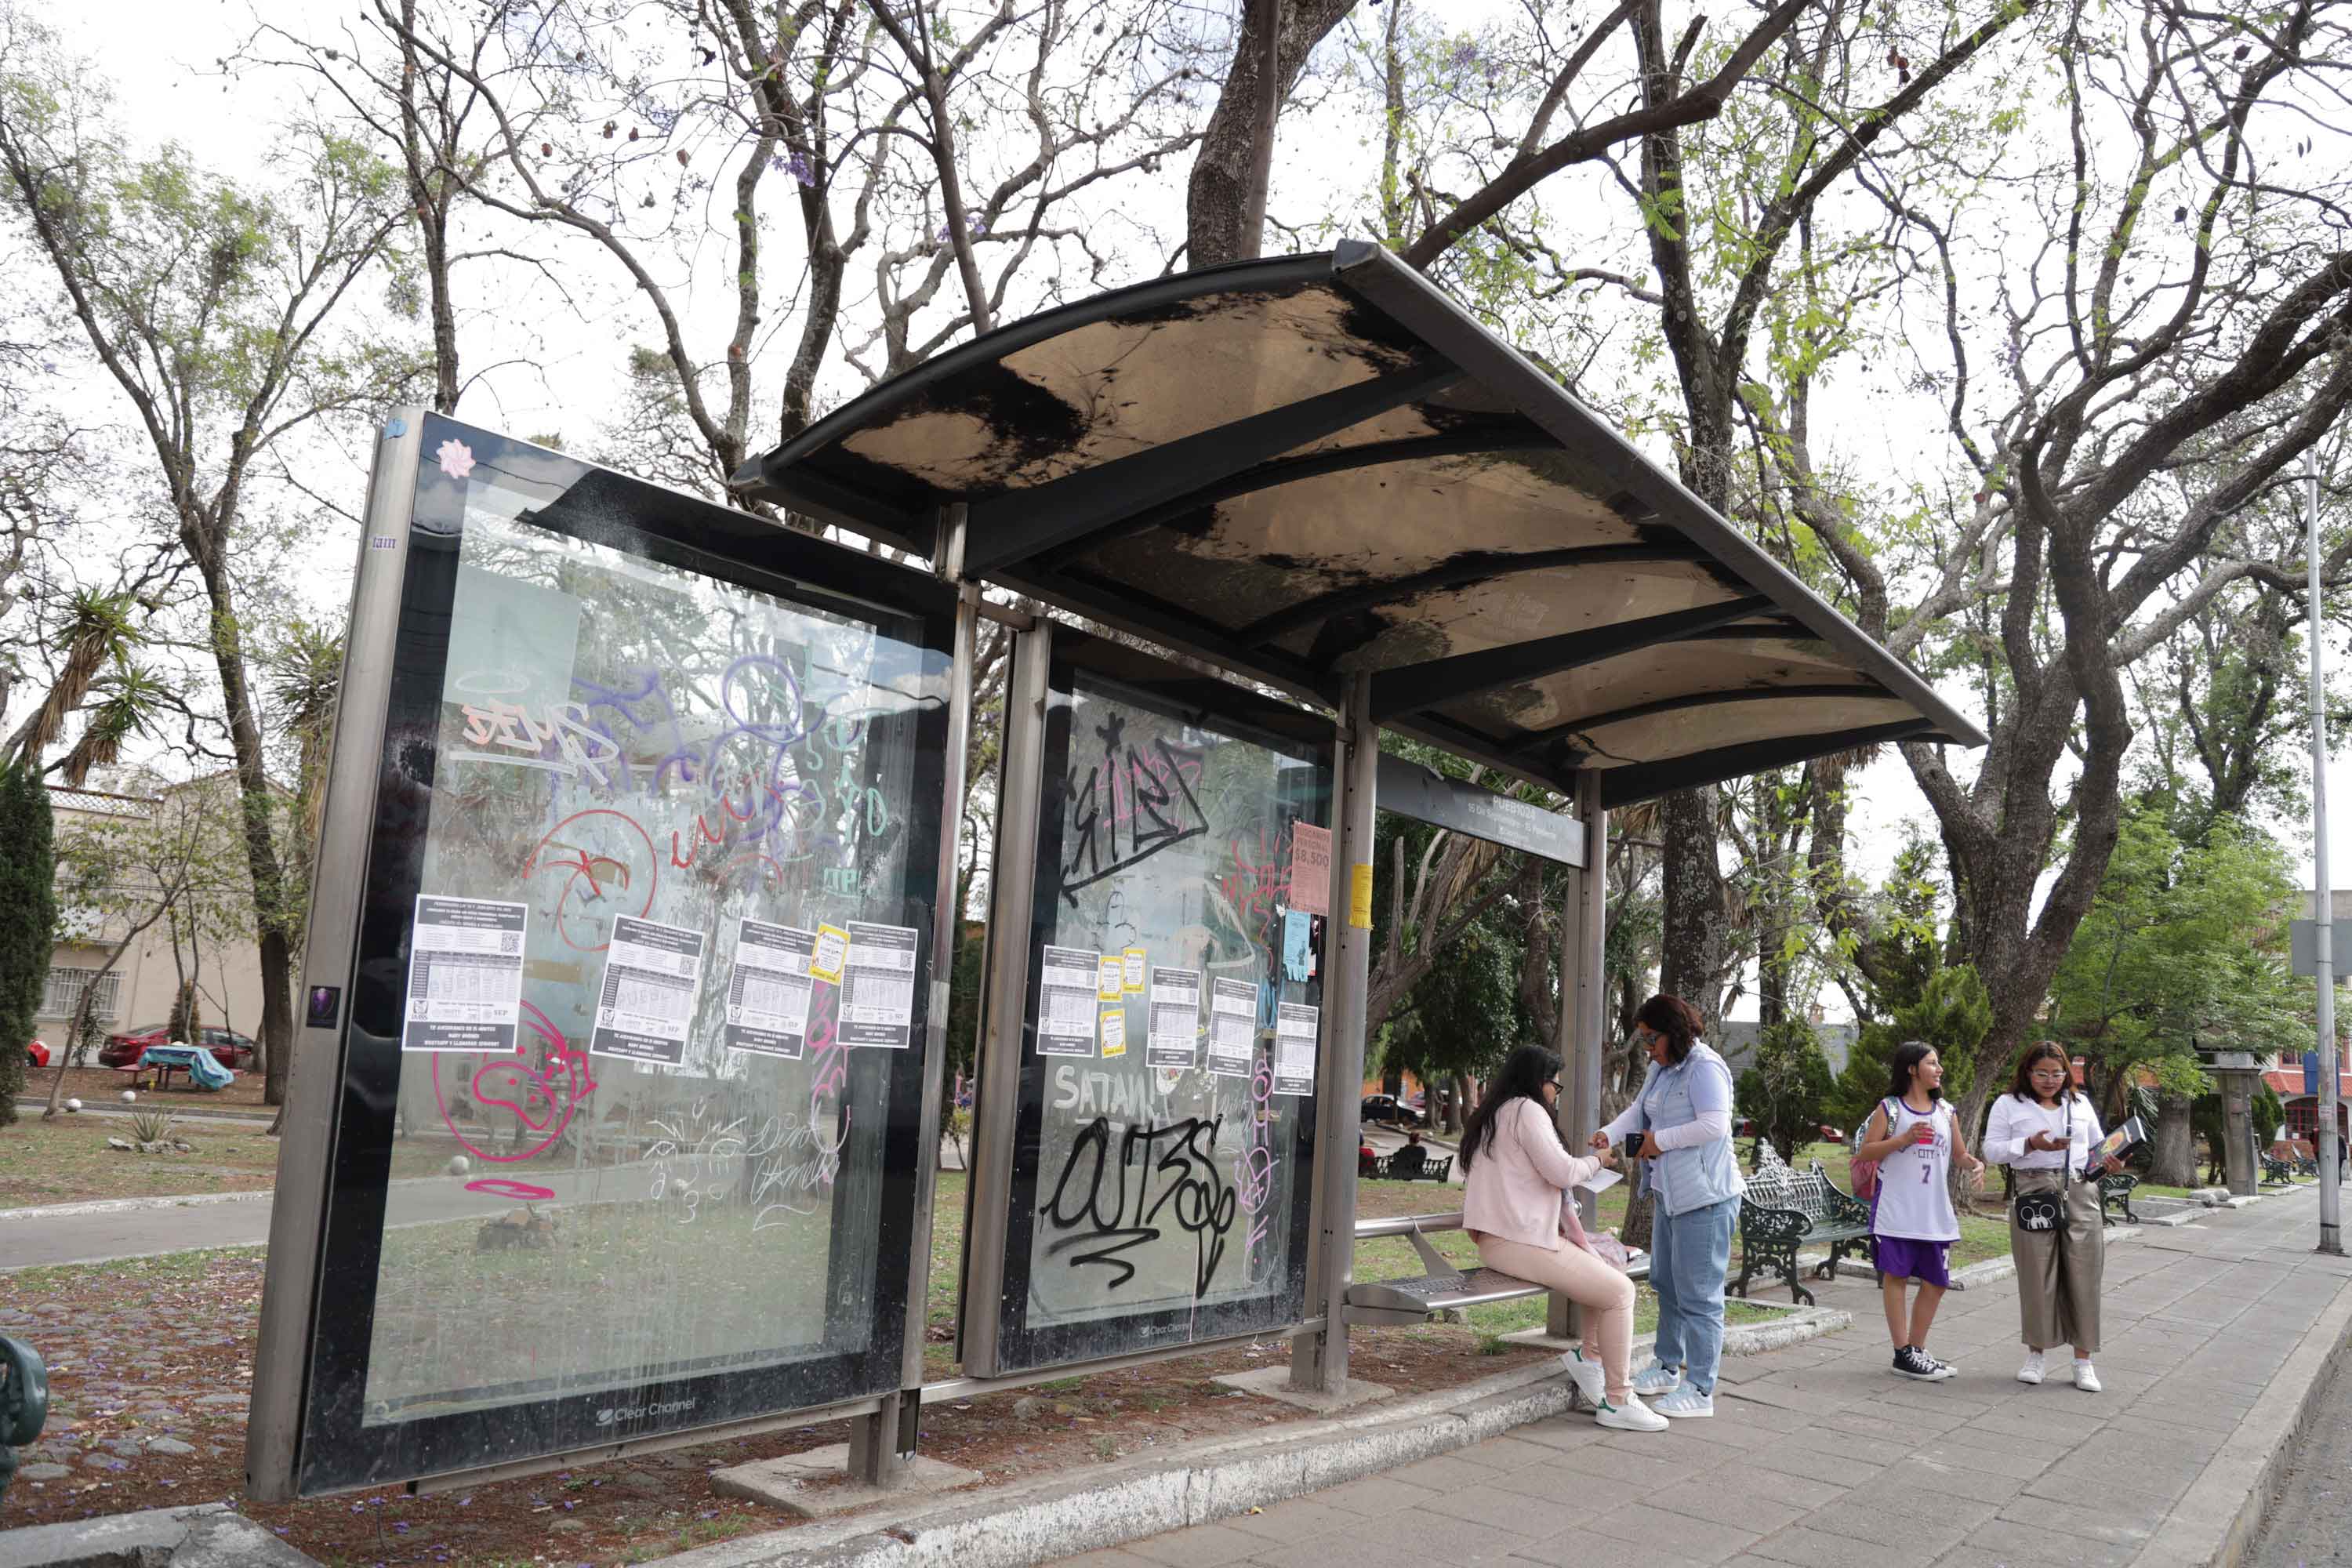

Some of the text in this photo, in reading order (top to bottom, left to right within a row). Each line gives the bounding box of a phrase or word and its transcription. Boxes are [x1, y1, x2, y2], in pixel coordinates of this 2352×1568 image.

[1918, 1149, 1935, 1159] CITY
[1922, 1164, 1931, 1185] 7
[615, 1397, 695, 1422] Clear Channel
